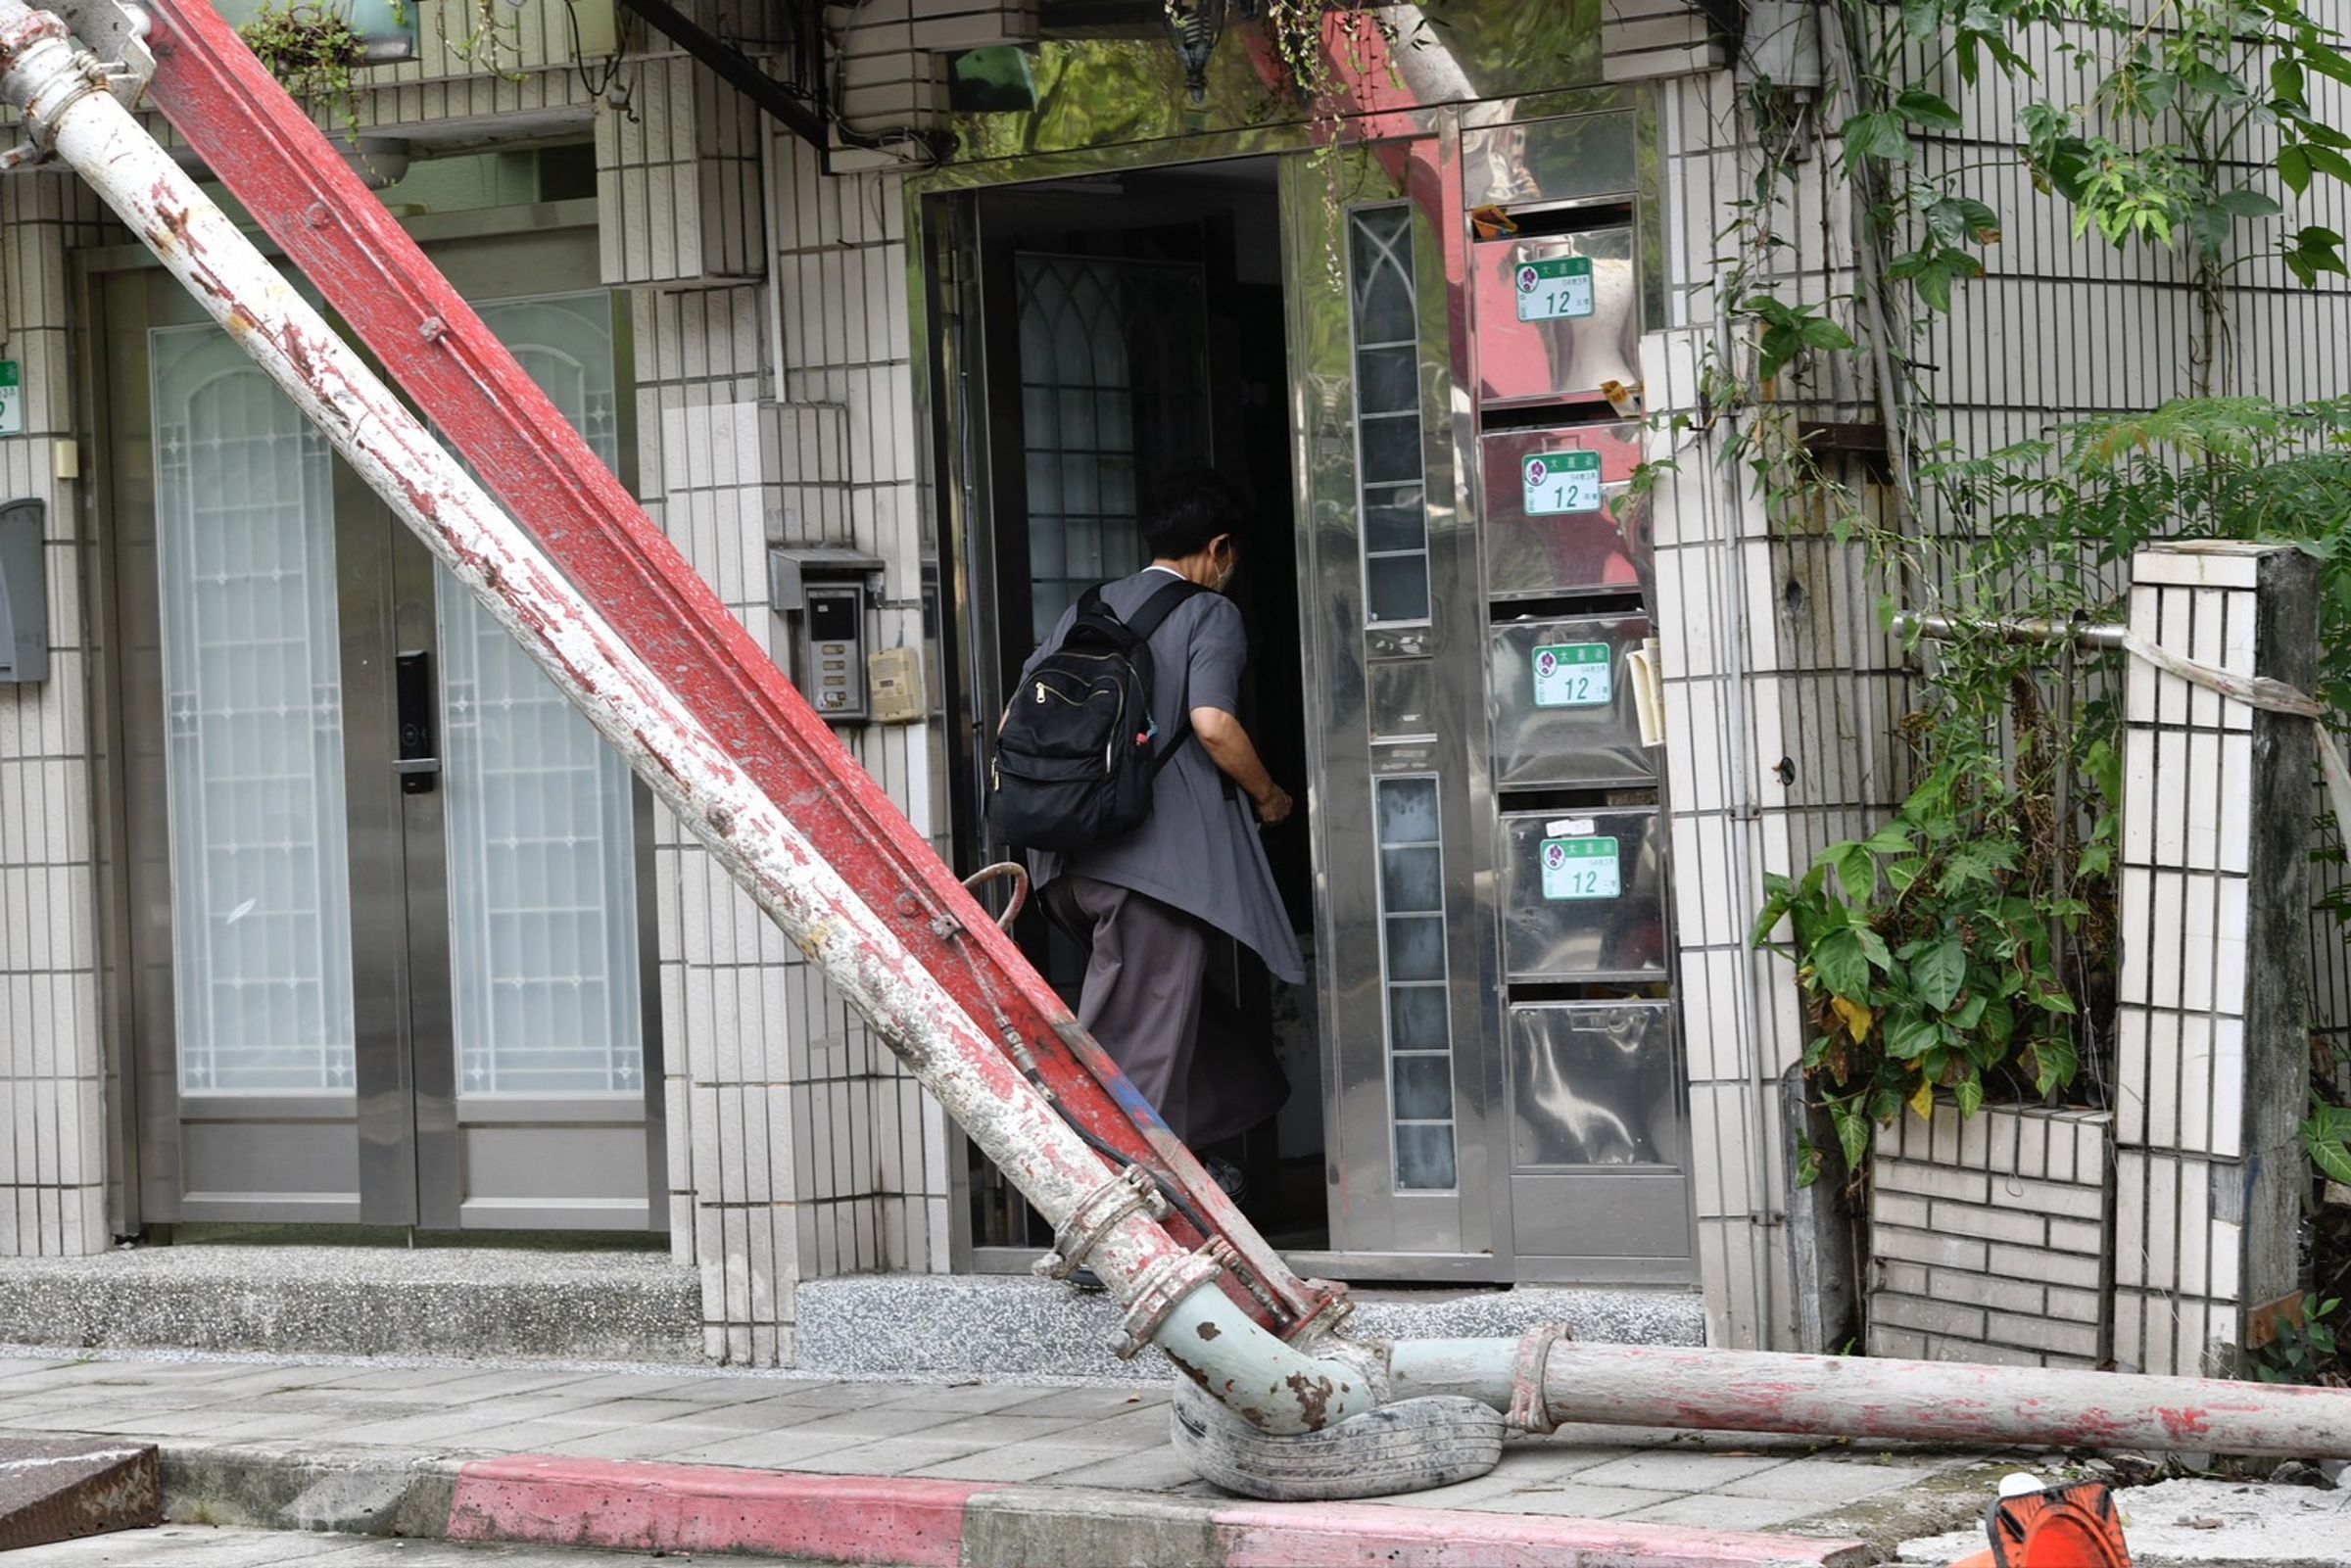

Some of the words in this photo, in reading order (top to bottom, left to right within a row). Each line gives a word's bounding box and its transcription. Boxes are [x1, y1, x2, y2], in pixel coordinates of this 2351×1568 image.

[1547, 291, 1571, 315] 12
[1555, 485, 1579, 508] 12
[1565, 677, 1589, 700] 12
[1573, 871, 1597, 893] 12
